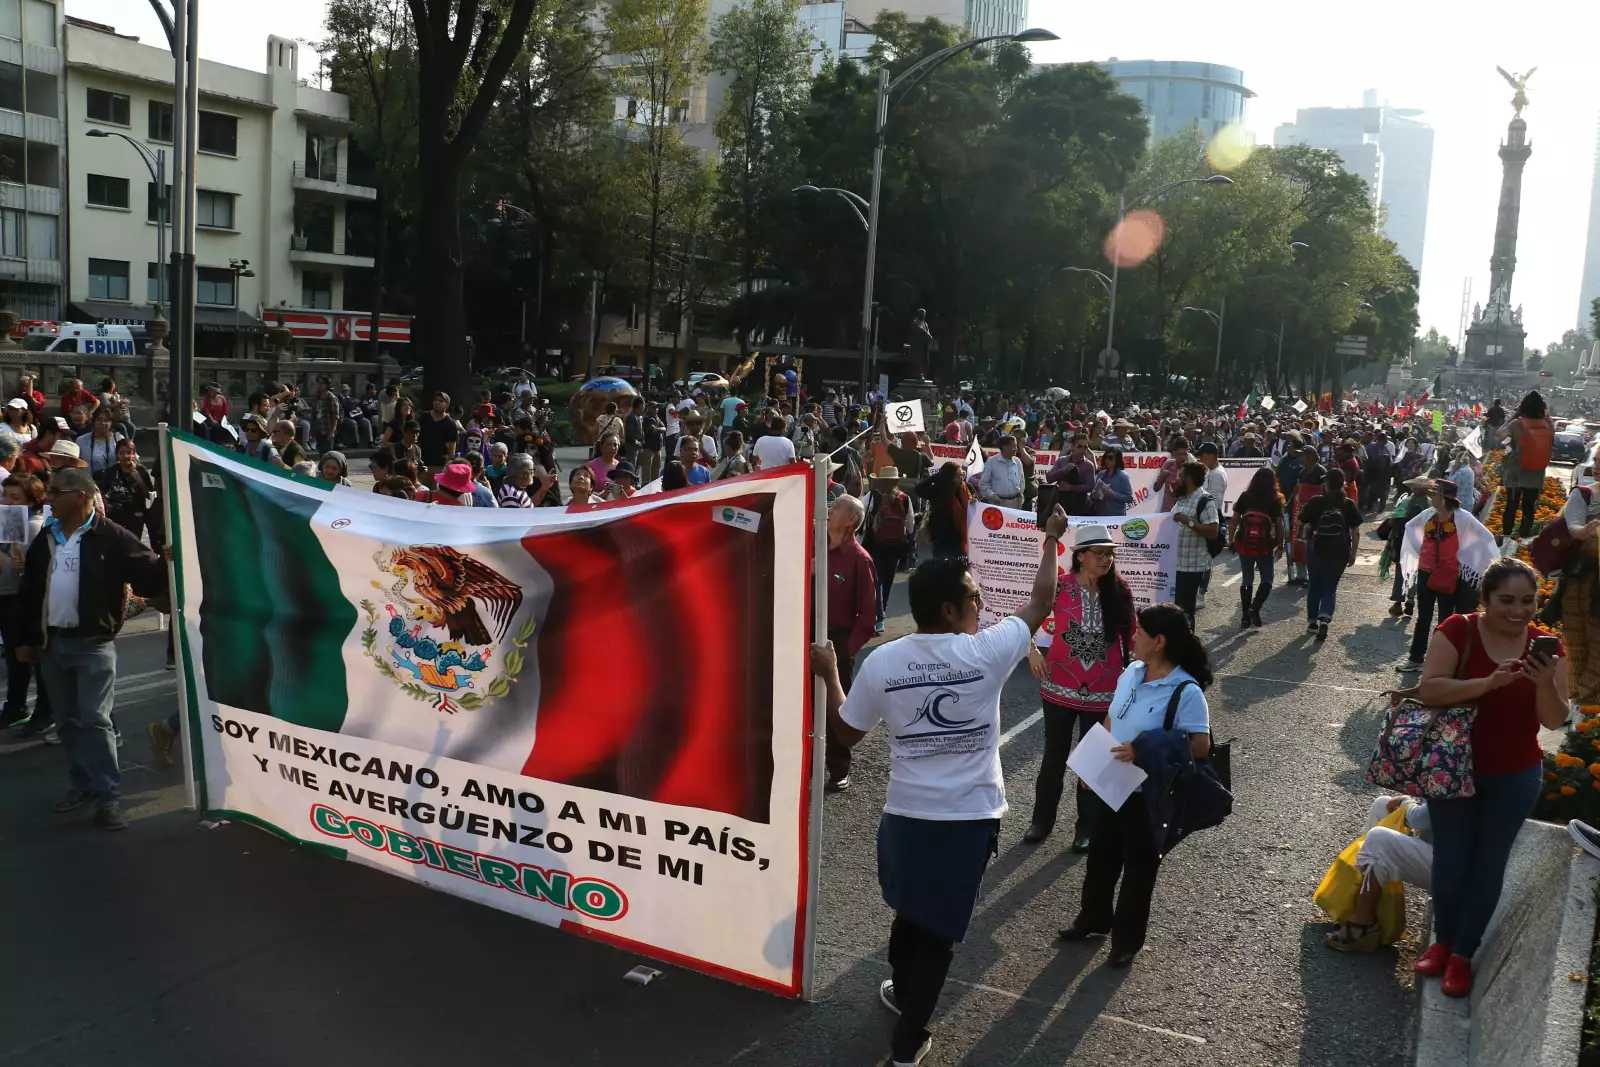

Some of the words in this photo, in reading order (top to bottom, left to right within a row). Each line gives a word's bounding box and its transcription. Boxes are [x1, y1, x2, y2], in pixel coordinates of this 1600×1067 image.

[97, 328, 108, 336] SSP
[1134, 486, 1149, 504] NO
[1005, 522, 1039, 531] AEROPU
[988, 532, 1010, 540] SECAR
[984, 558, 1039, 569] HUNDIMIENTOS
[995, 587, 1011, 595] MÁS
[908, 662, 951, 672] Congreso
[885, 674, 926, 687] Nacional
[928, 669, 980, 682] Ciudadano
[211, 714, 260, 744] SOY
[269, 730, 449, 797] MEXICANO,
[461, 778, 545, 814] AMO
[557, 800, 586, 825] A
[599, 807, 647, 836] MI
[664, 819, 770, 871] PAÍS,
[253, 753, 269, 773] Y
[278, 763, 320, 792] ME
[328, 779, 573, 854] AVERGÜENZO
[588, 839, 642, 871] DE
[658, 853, 704, 886] MI
[310, 803, 629, 922] GOBIERNO
